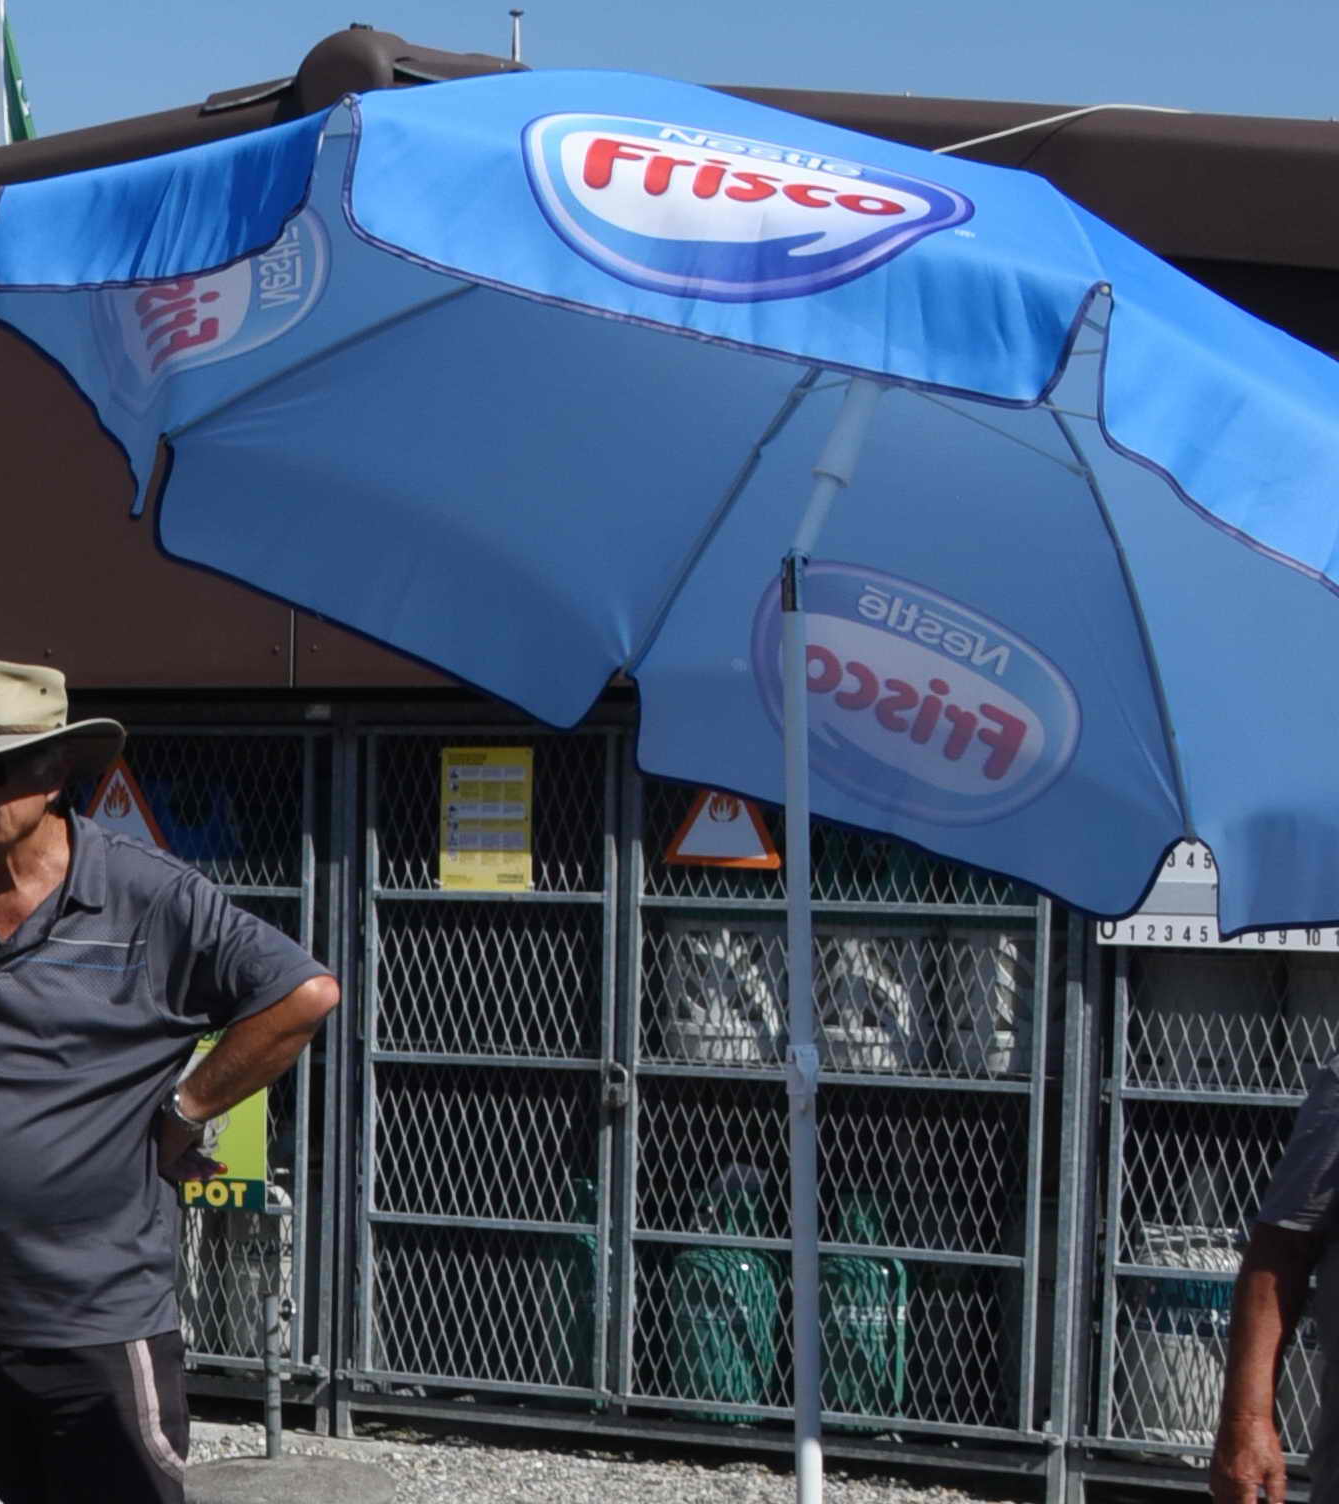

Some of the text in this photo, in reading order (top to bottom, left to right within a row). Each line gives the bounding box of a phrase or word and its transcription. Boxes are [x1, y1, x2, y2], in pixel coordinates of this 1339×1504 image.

[582, 137, 907, 217] Frisco
[1186, 851, 1195, 869] 4
[1203, 852, 1212, 870] 5
[1129, 924, 1136, 941] 1
[1146, 924, 1156, 942] 2
[1164, 924, 1174, 942] 3
[1183, 925, 1192, 943] 4
[1199, 925, 1209, 943] 5
[1257, 930, 1267, 945] 8
[1278, 929, 1288, 945] 9
[1305, 928, 1321, 946] 10
[183, 1180, 248, 1208] POT
